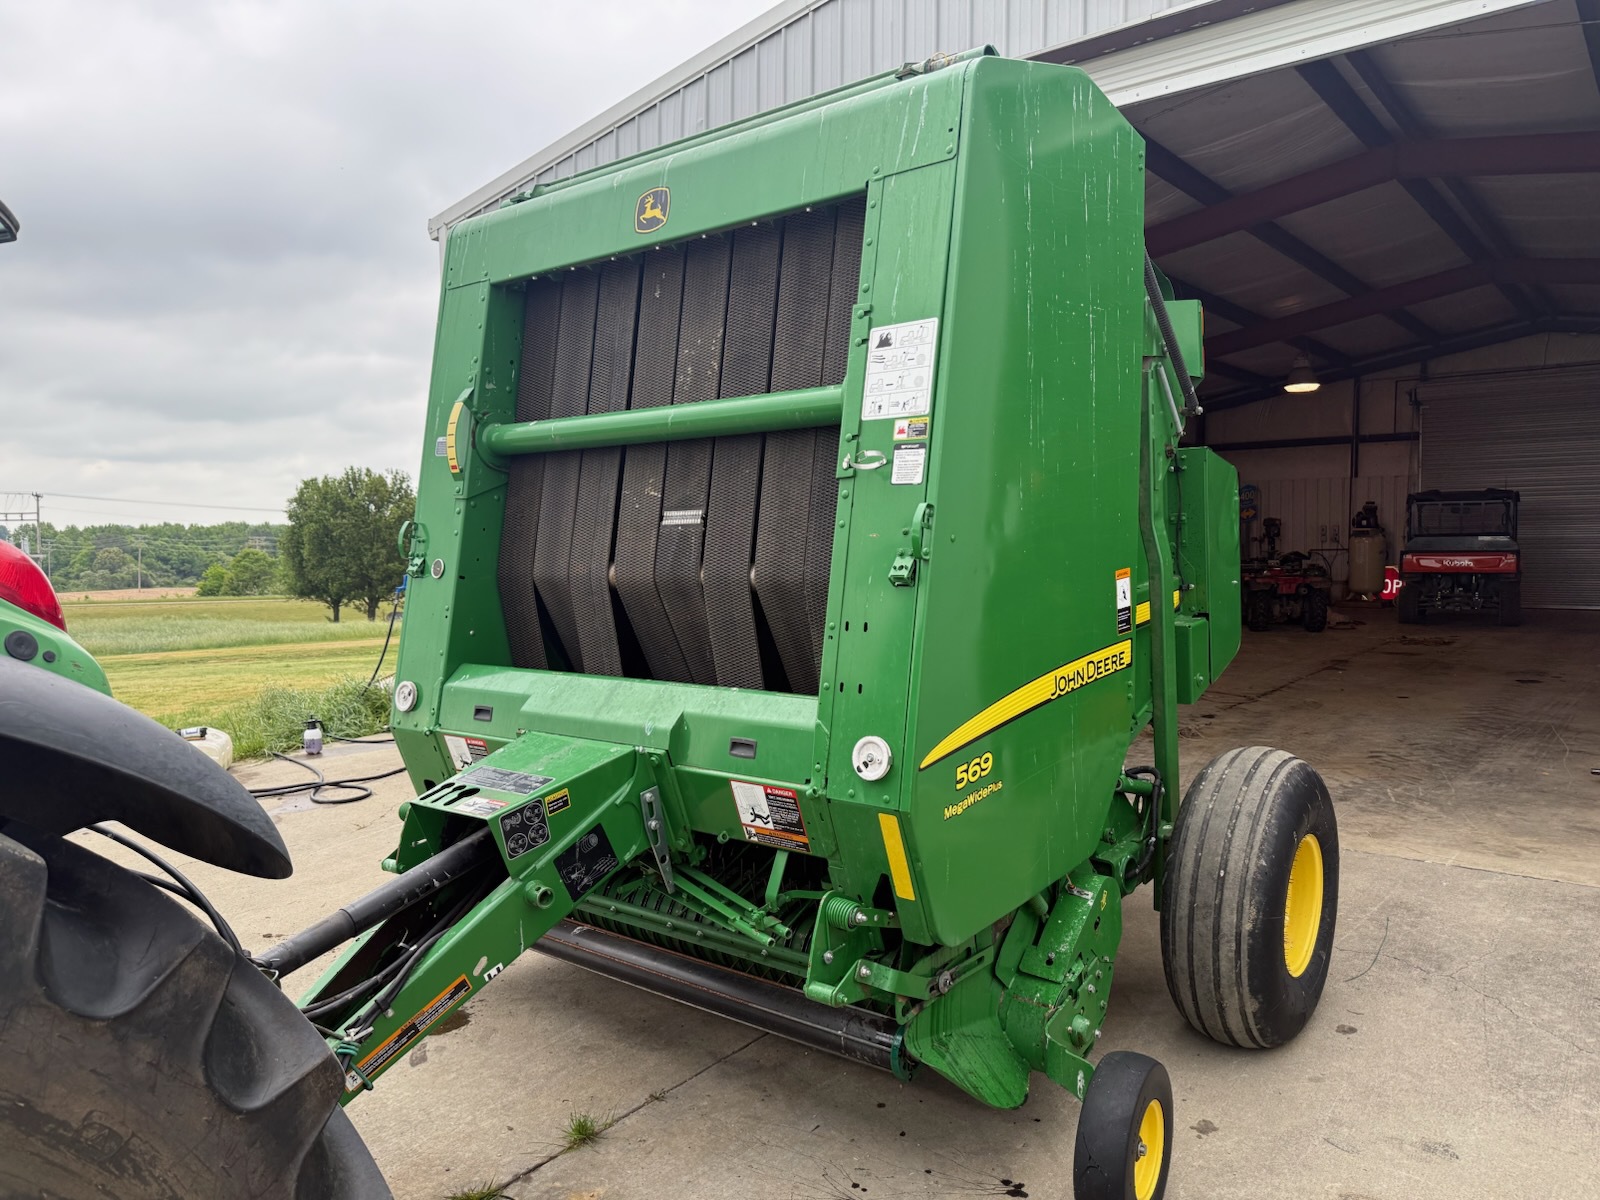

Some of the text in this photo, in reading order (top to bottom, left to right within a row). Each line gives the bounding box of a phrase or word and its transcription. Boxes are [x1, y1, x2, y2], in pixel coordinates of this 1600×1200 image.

[1443, 559, 1473, 567] Kubota
[1382, 579, 1403, 594] OP
[1050, 651, 1125, 697] JOHN DEERE
[955, 751, 993, 791] 569
[771, 788, 793, 797] DANGER
[944, 780, 1003, 821] MegaWidePlus
